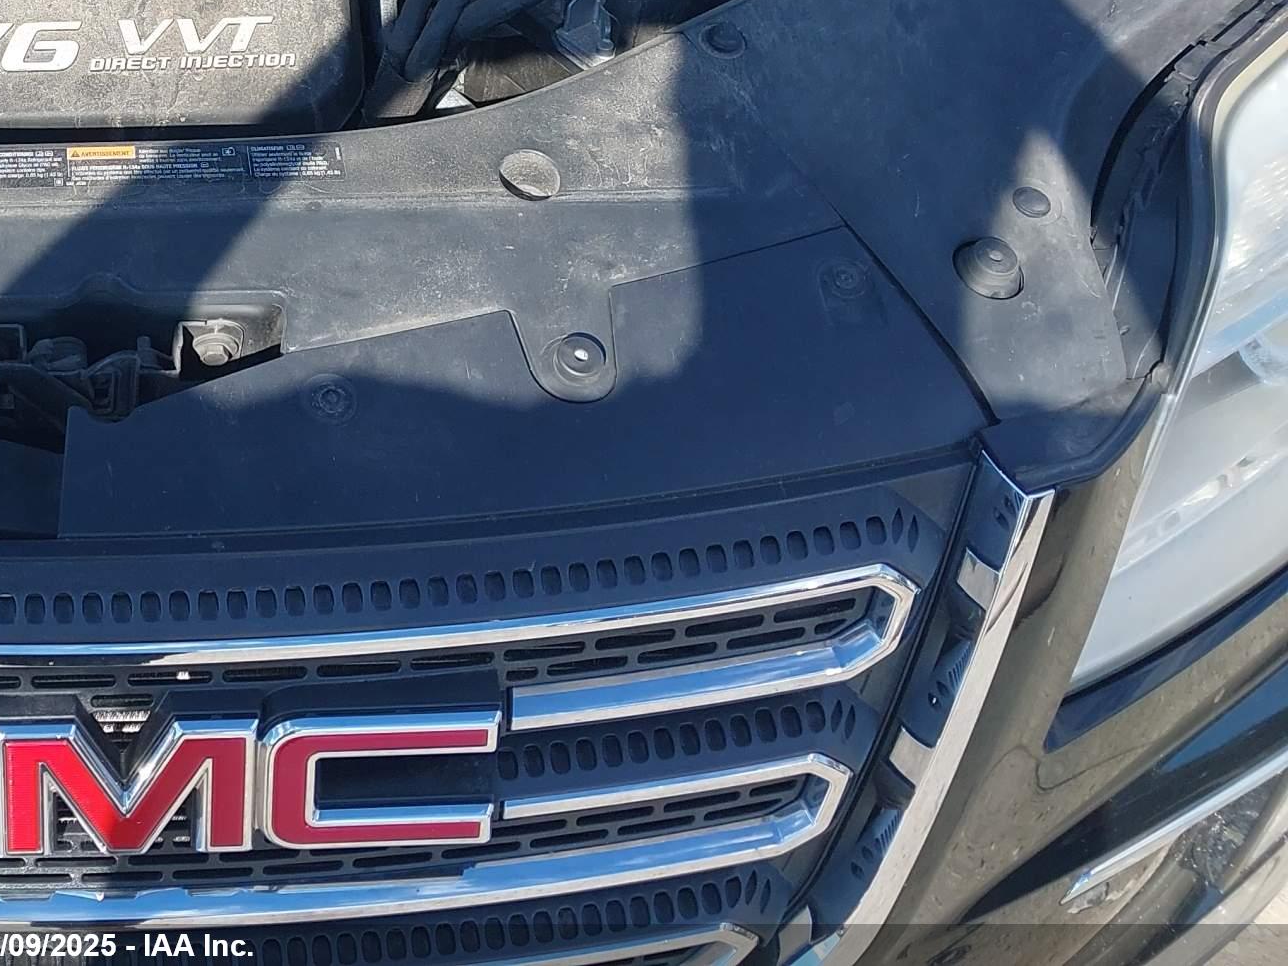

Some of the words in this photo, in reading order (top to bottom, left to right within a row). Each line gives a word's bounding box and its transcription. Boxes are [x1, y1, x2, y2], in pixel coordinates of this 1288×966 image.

[117, 15, 275, 55] VVT
[90, 55, 172, 72] DIRECT
[180, 52, 297, 70] INJECTION
